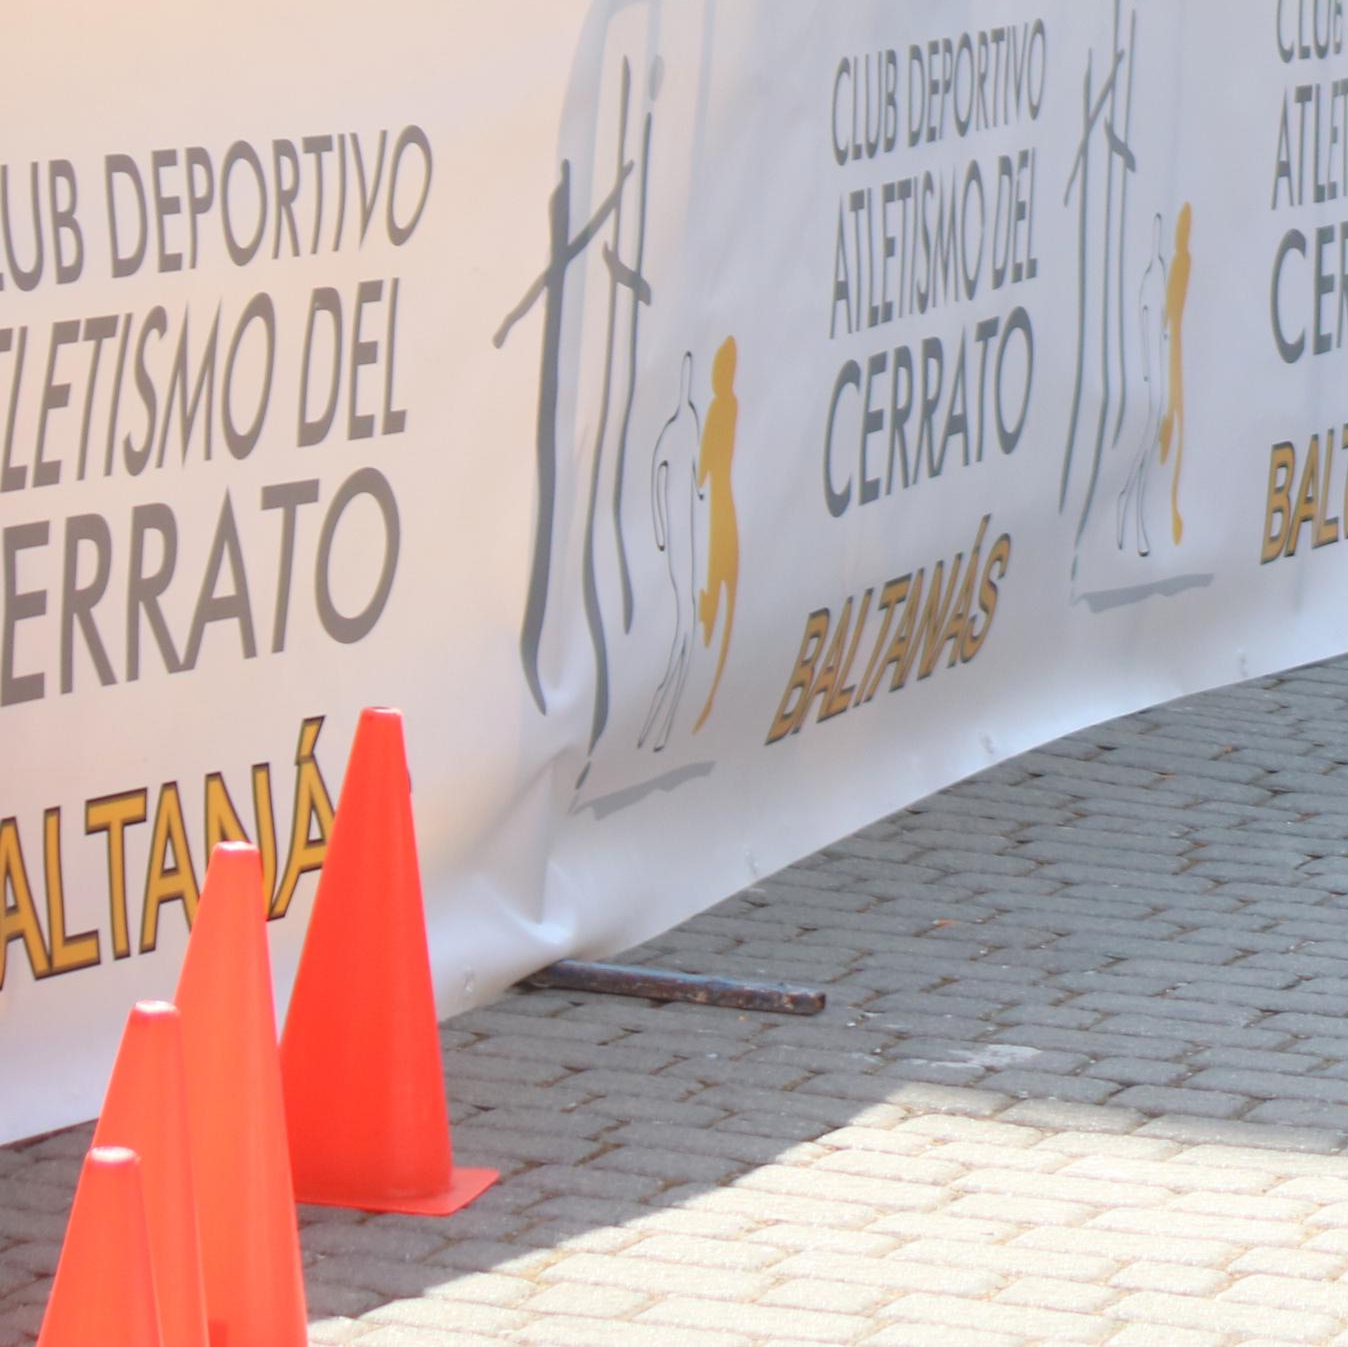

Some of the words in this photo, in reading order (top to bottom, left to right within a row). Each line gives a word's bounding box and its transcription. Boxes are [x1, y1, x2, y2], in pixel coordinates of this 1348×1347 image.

[831, 49, 898, 166] CLUB
[907, 18, 1047, 148] DEPORTIVO
[105, 125, 434, 279] DEPORTIVO
[829, 159, 986, 340] ATLETISMO
[992, 146, 1039, 291] DEL
[297, 277, 408, 448] DEL
[823, 305, 1035, 519] CERRATO
[764, 513, 1012, 746] BALTANÁS
[0, 714, 336, 992] ALTANÁ
